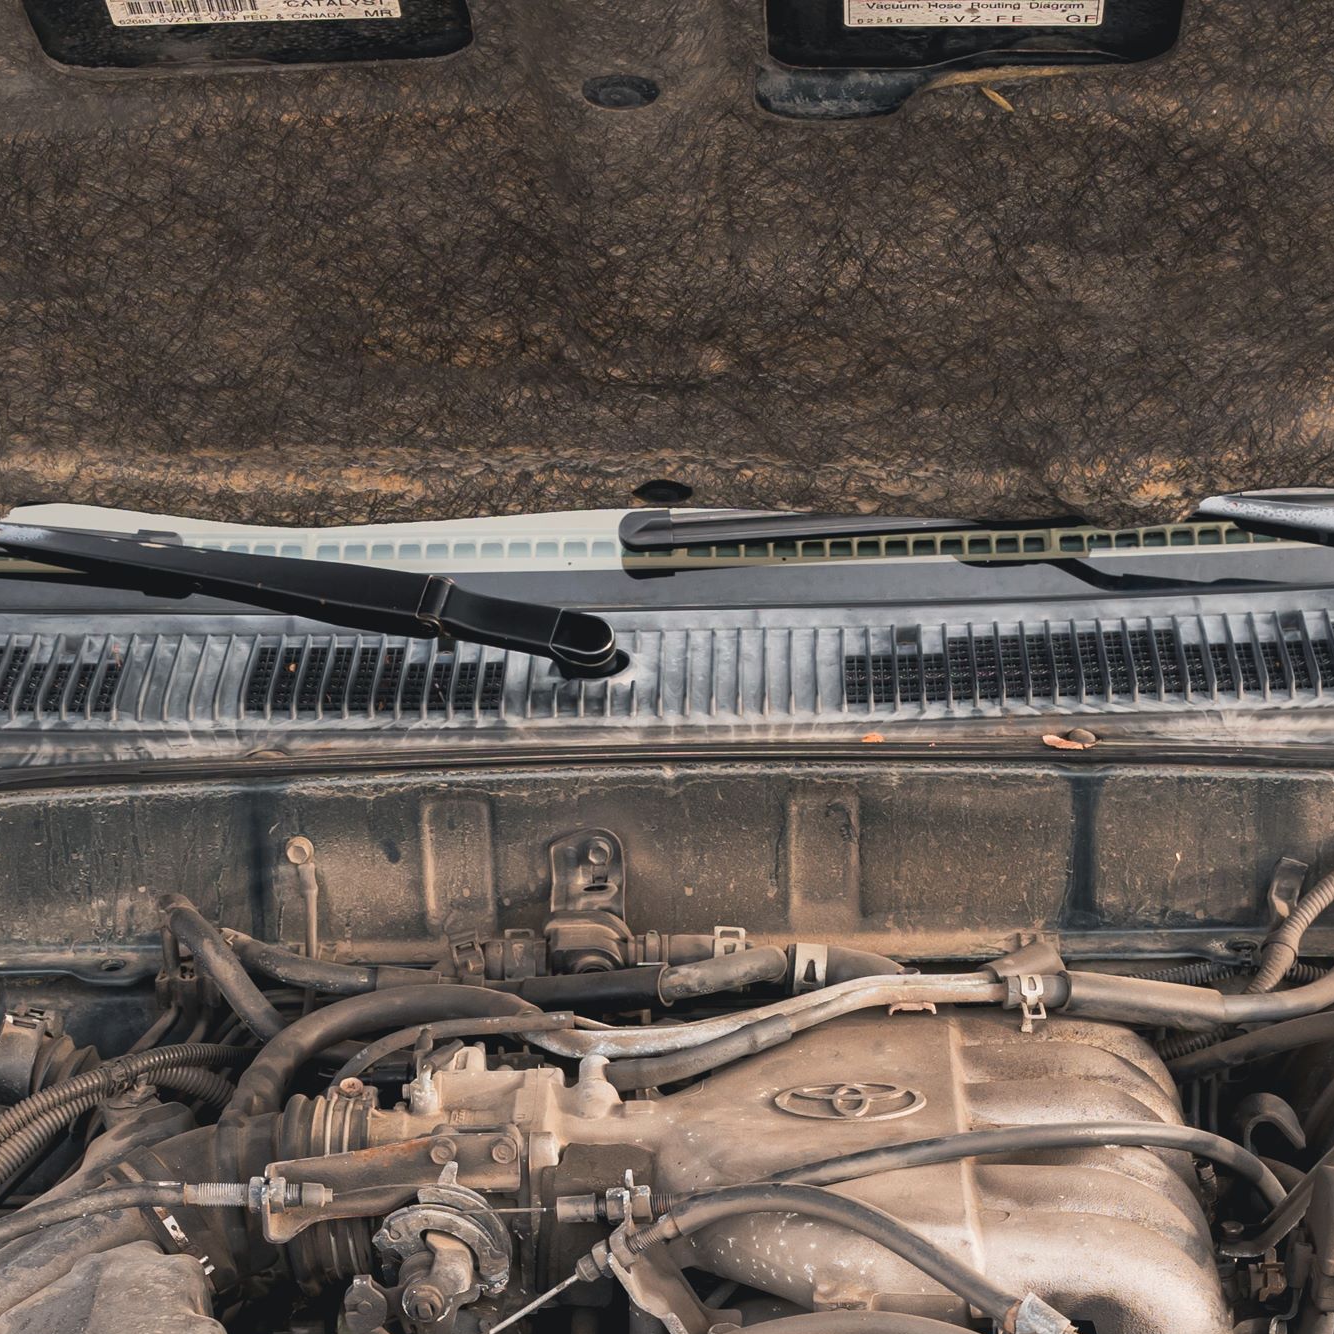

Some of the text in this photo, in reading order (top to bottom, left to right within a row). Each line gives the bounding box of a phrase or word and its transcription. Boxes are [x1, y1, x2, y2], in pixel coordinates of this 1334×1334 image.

[866, 2, 1085, 11] Vacuum Hose Routing Diagram
[939, 15, 1023, 23] 5VZ-FE
[1065, 15, 1098, 23] GF
